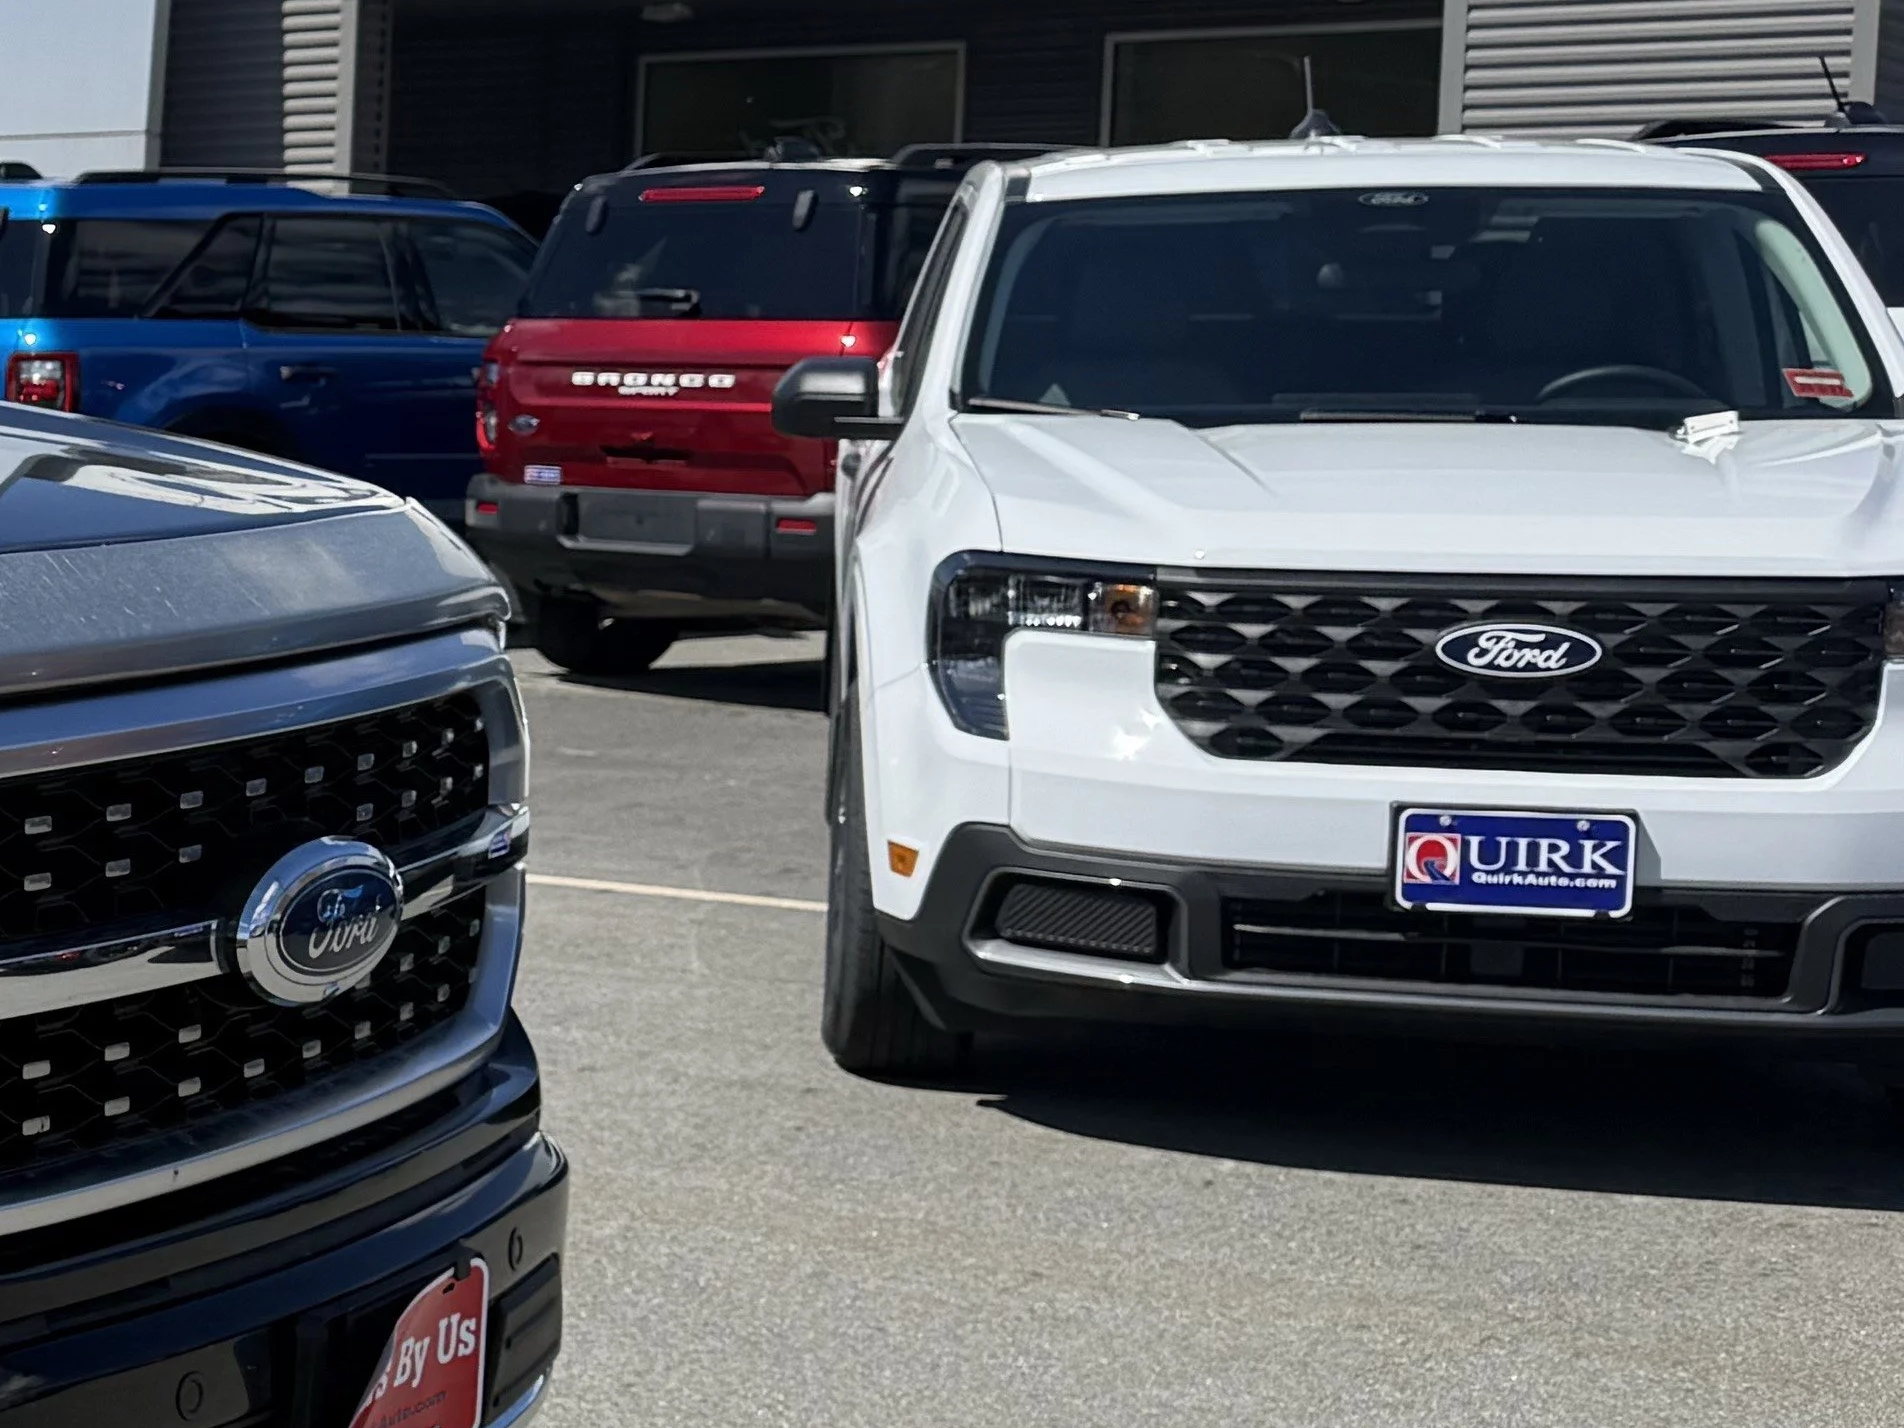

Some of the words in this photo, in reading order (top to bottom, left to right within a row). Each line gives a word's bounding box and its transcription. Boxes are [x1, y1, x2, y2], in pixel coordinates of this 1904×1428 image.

[571, 371, 737, 388] BRONCO
[1466, 630, 1573, 670] Ford
[1404, 834, 1627, 885] QUIRK
[1470, 871, 1618, 890] QuirkAuto.com
[308, 884, 384, 959] Ford
[393, 1336, 431, 1389] By
[438, 1312, 477, 1365] Us
